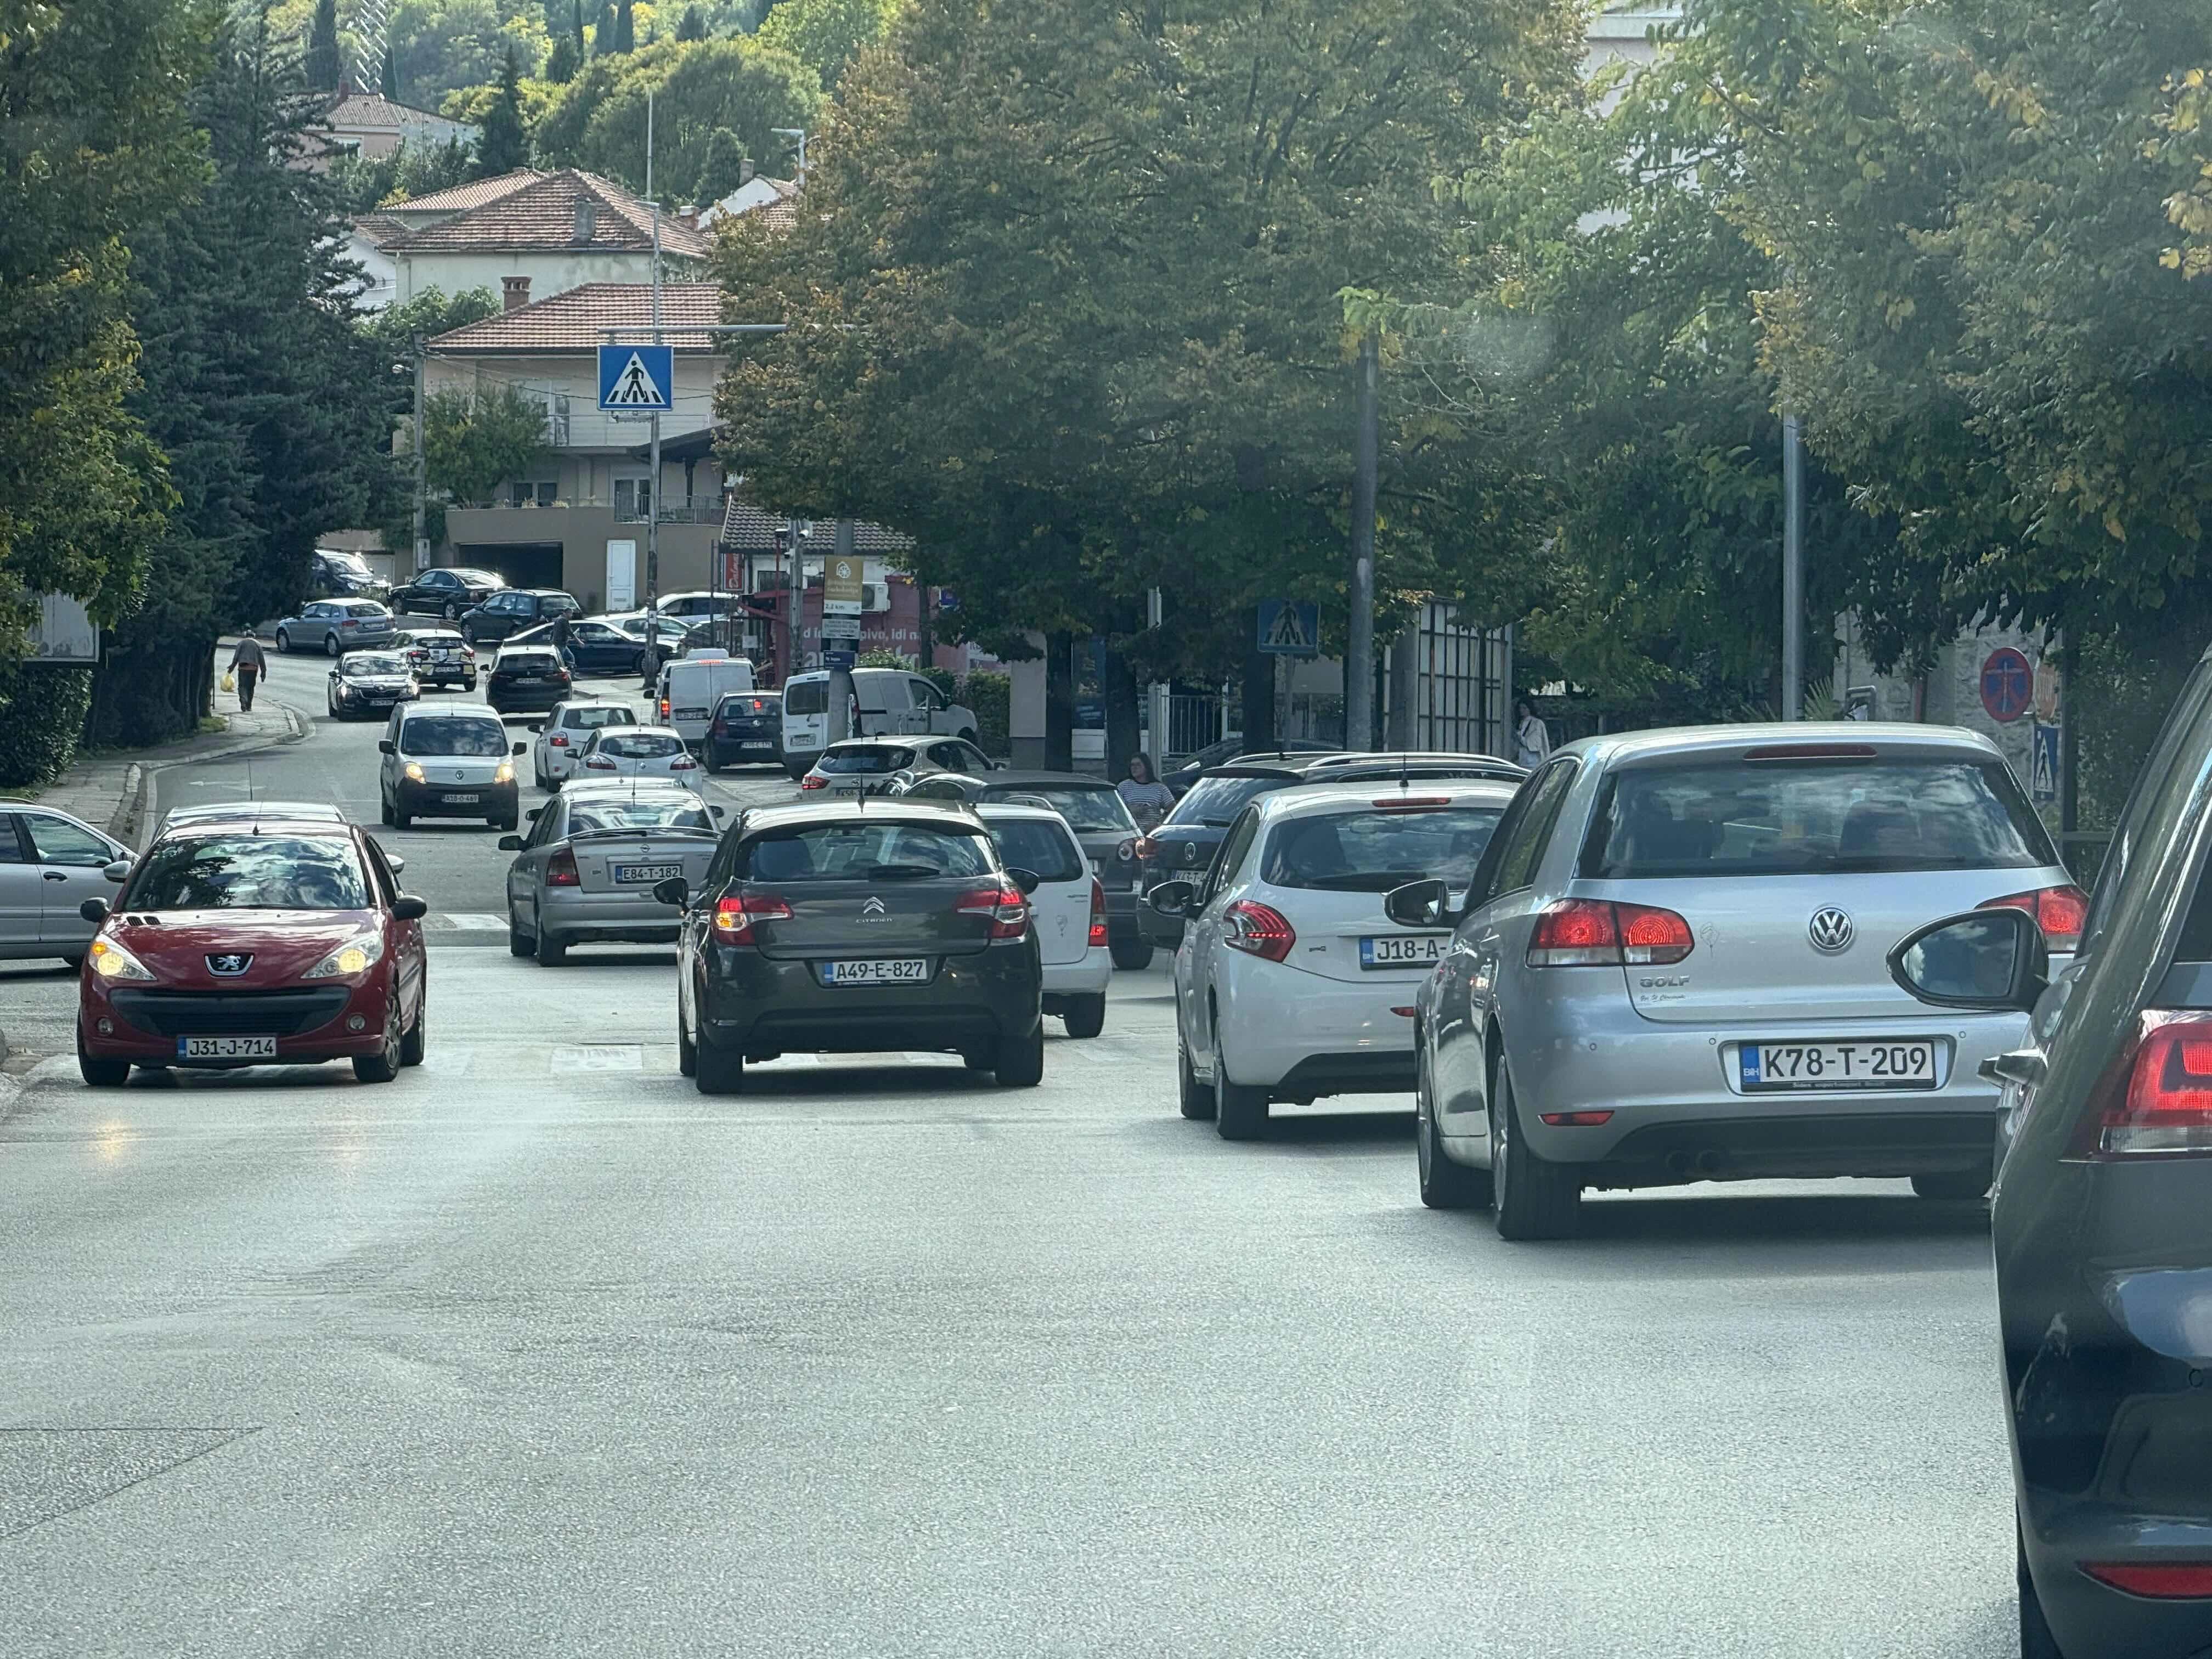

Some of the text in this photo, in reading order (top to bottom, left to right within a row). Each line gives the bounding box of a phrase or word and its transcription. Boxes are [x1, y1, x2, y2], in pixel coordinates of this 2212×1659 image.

[624, 867, 678, 879] E84-T-182
[1176, 872, 1206, 883] K43-T-4
[1378, 940, 1447, 960] J18-A-
[837, 962, 924, 979] A49-E-827
[1640, 976, 1690, 988] GOLF
[189, 1040, 274, 1055] J31-J-714
[1764, 1047, 1927, 1077] K78-T-209
